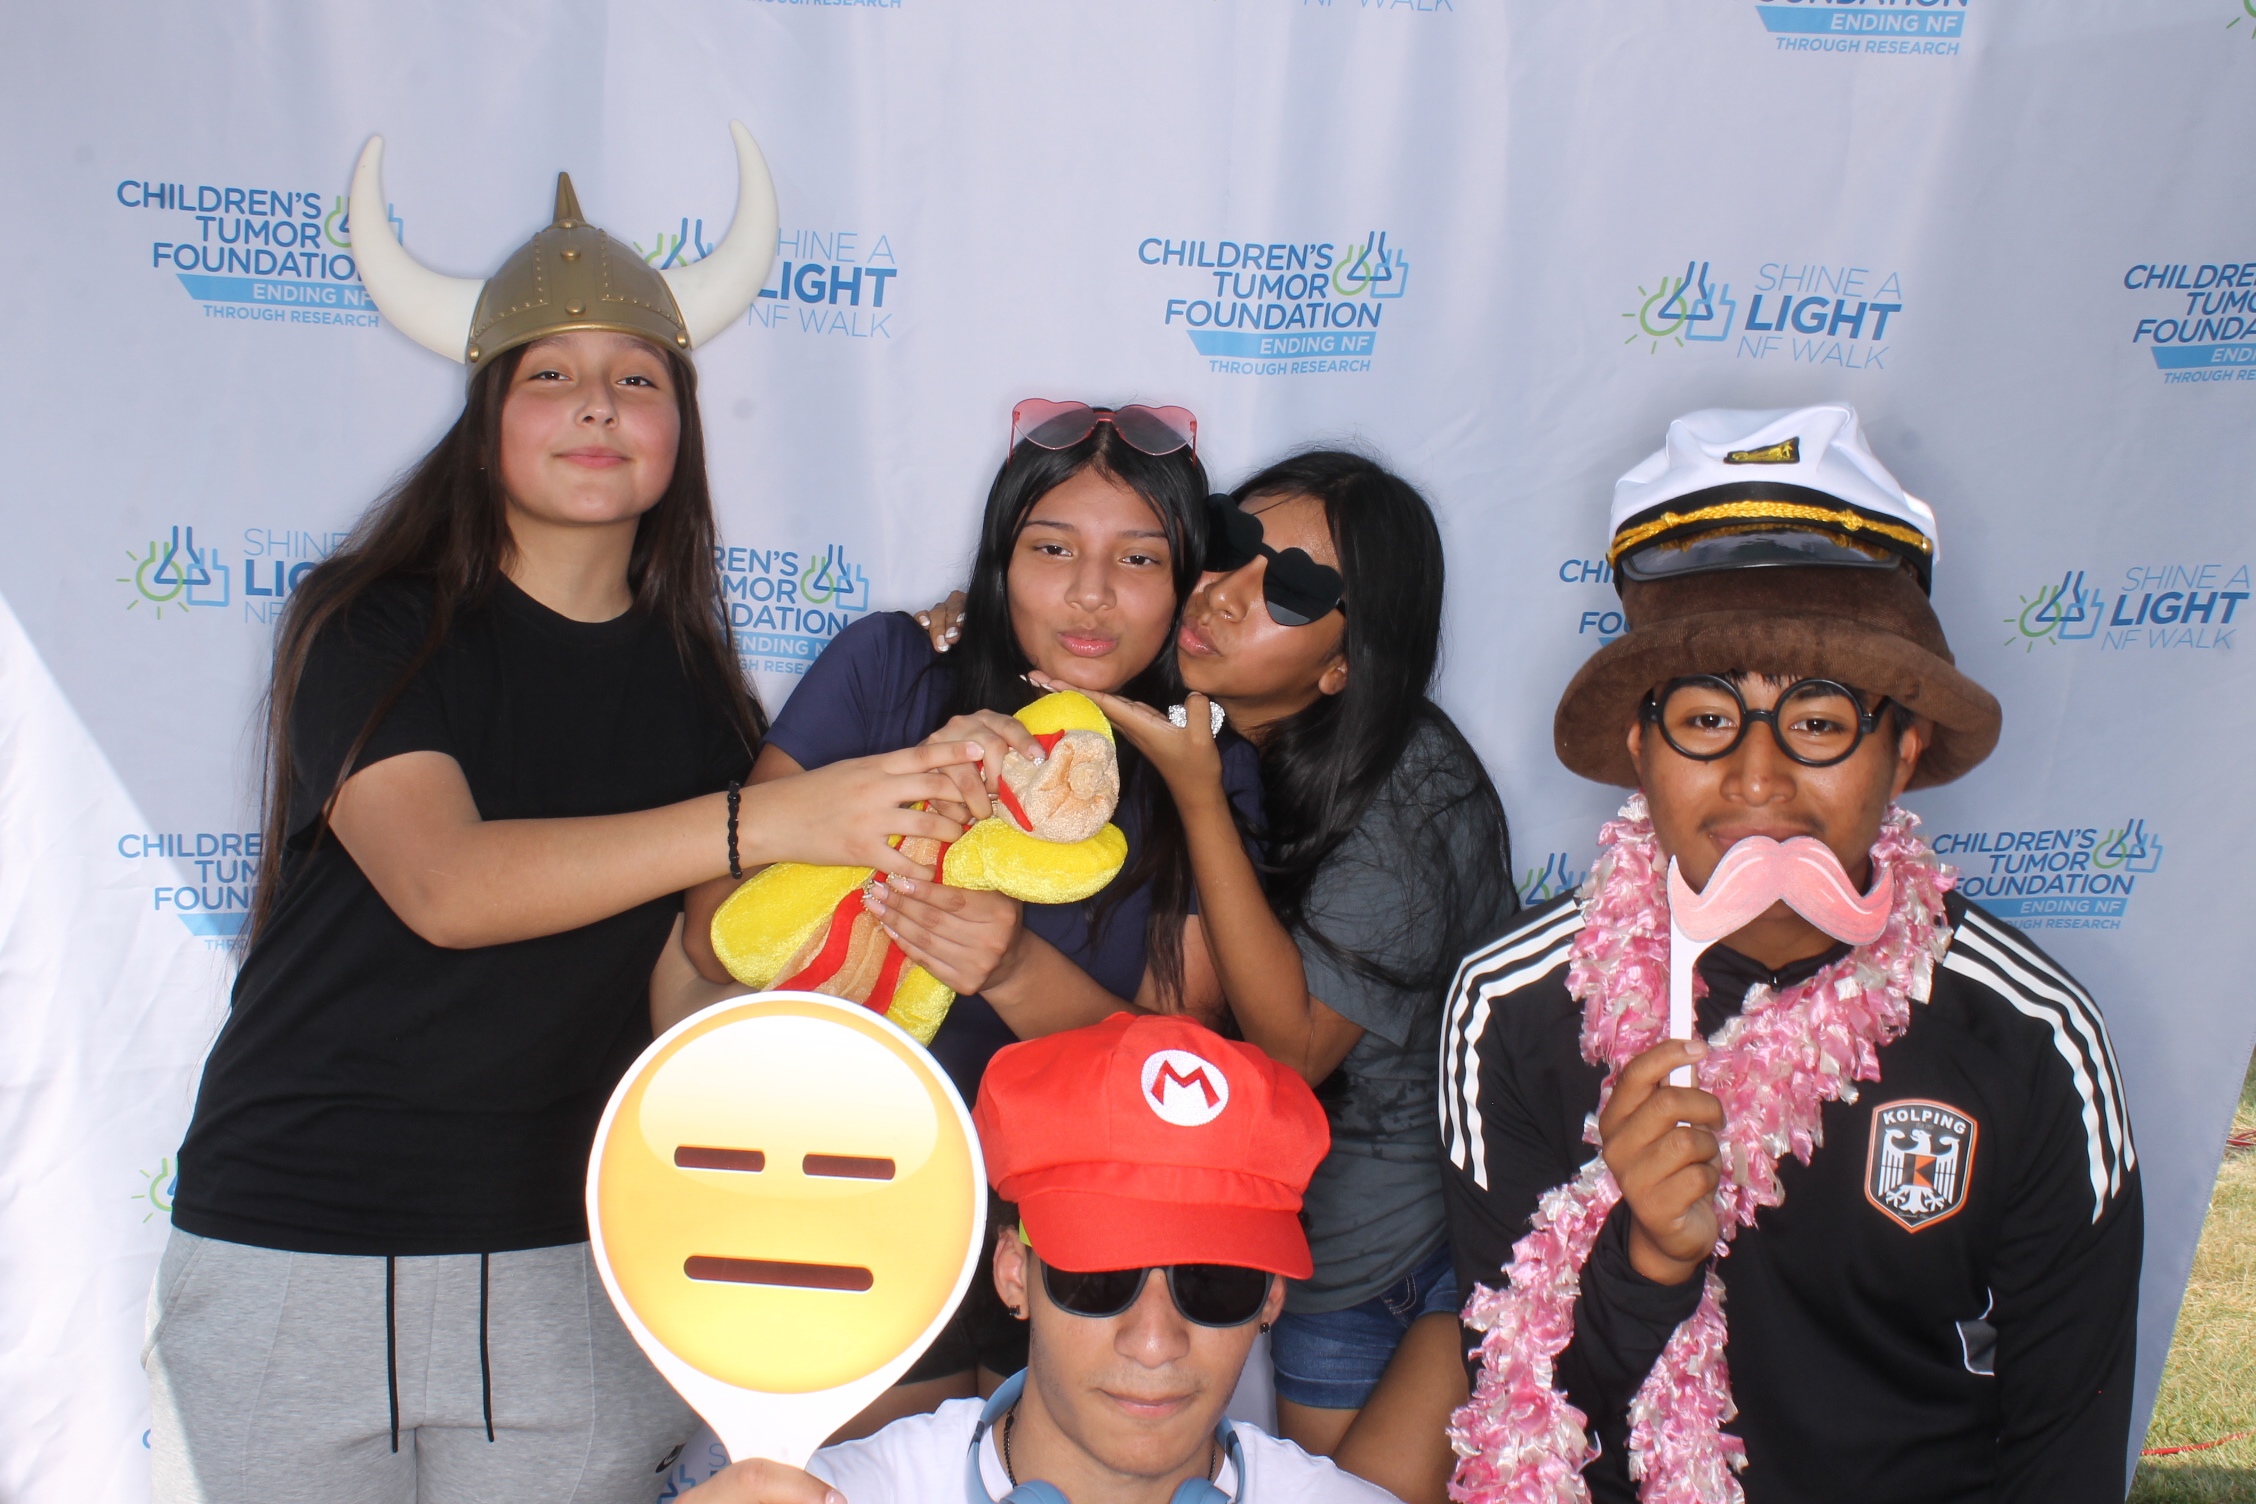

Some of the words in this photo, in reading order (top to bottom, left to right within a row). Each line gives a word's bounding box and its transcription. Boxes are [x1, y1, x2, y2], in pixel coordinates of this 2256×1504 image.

[1830, 13, 1919, 32] ENDING
[1925, 15, 1959, 33] NF
[1776, 36, 1861, 52] THROUGH
[1865, 39, 1961, 56] RESEARCH
[116, 180, 322, 220] CHILDREN'S
[195, 215, 321, 250] TUMOR
[777, 228, 858, 262] HINE
[867, 234, 896, 264] A
[153, 242, 362, 282] FOUNDATIO
[1138, 238, 1334, 271] CHILDREN'S
[1213, 271, 1329, 300] TUMOR
[1755, 263, 1870, 298] SHINE
[1873, 272, 1903, 300] A
[2124, 263, 2256, 289] CHILDRE
[253, 283, 337, 305] ENDING
[203, 304, 286, 323] THROUGH
[290, 306, 379, 328] RESEARCH
[748, 302, 790, 329] NF
[799, 307, 892, 338] WALK
[1165, 299, 1382, 330] FOUNDATION
[1744, 294, 1903, 341] LIGHT
[1260, 336, 1335, 355] ENDING
[1341, 335, 1370, 352] NF
[1737, 335, 1783, 359] NF
[1793, 337, 1890, 369] WALK
[1209, 359, 1287, 376] THROUGH
[1290, 359, 1371, 375] RESEARCH
[2164, 370, 2234, 384] THROUGH
[713, 546, 799, 577] REN'S
[721, 574, 798, 604] MOR
[2121, 564, 2222, 591] SHINE
[2224, 564, 2250, 589] A
[713, 602, 848, 636] DATION
[2109, 591, 2250, 627] LIGHT
[2101, 628, 2142, 650] NF
[2149, 628, 2237, 649] WALK
[118, 833, 262, 858] CHILDRE
[1932, 828, 2098, 855] CHILDREN'S
[194, 860, 260, 884] TUM
[1989, 851, 2091, 875] TUMOR
[2020, 900, 2090, 914] ENDING
[2095, 900, 2122, 913] NF
[2046, 918, 2121, 930] RESEARCH
[1150, 1059, 1221, 1109] M
[1882, 1108, 1967, 1135] KOLPING
